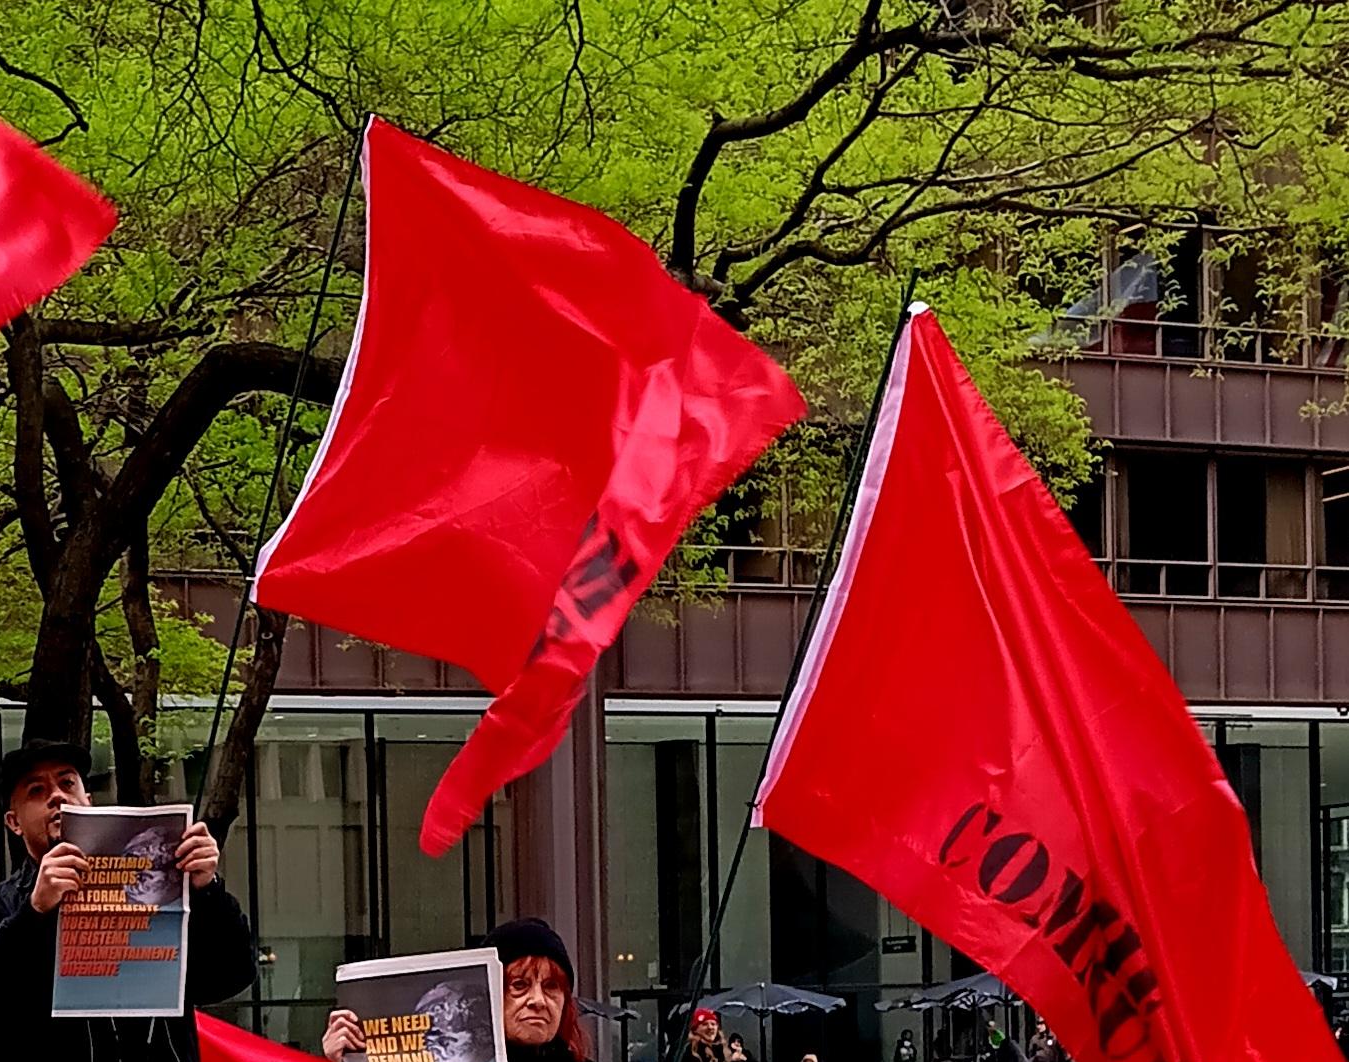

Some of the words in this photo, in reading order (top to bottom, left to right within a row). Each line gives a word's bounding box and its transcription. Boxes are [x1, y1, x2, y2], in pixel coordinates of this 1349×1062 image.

[84, 856, 154, 870] CESITAMOS
[87, 889, 127, 903] FORMA
[79, 931, 130, 946] SISTEMA
[363, 1018, 389, 1036] WE
[392, 1012, 431, 1033] NEED
[365, 1037, 398, 1054] AND
[401, 1033, 427, 1051] WE
